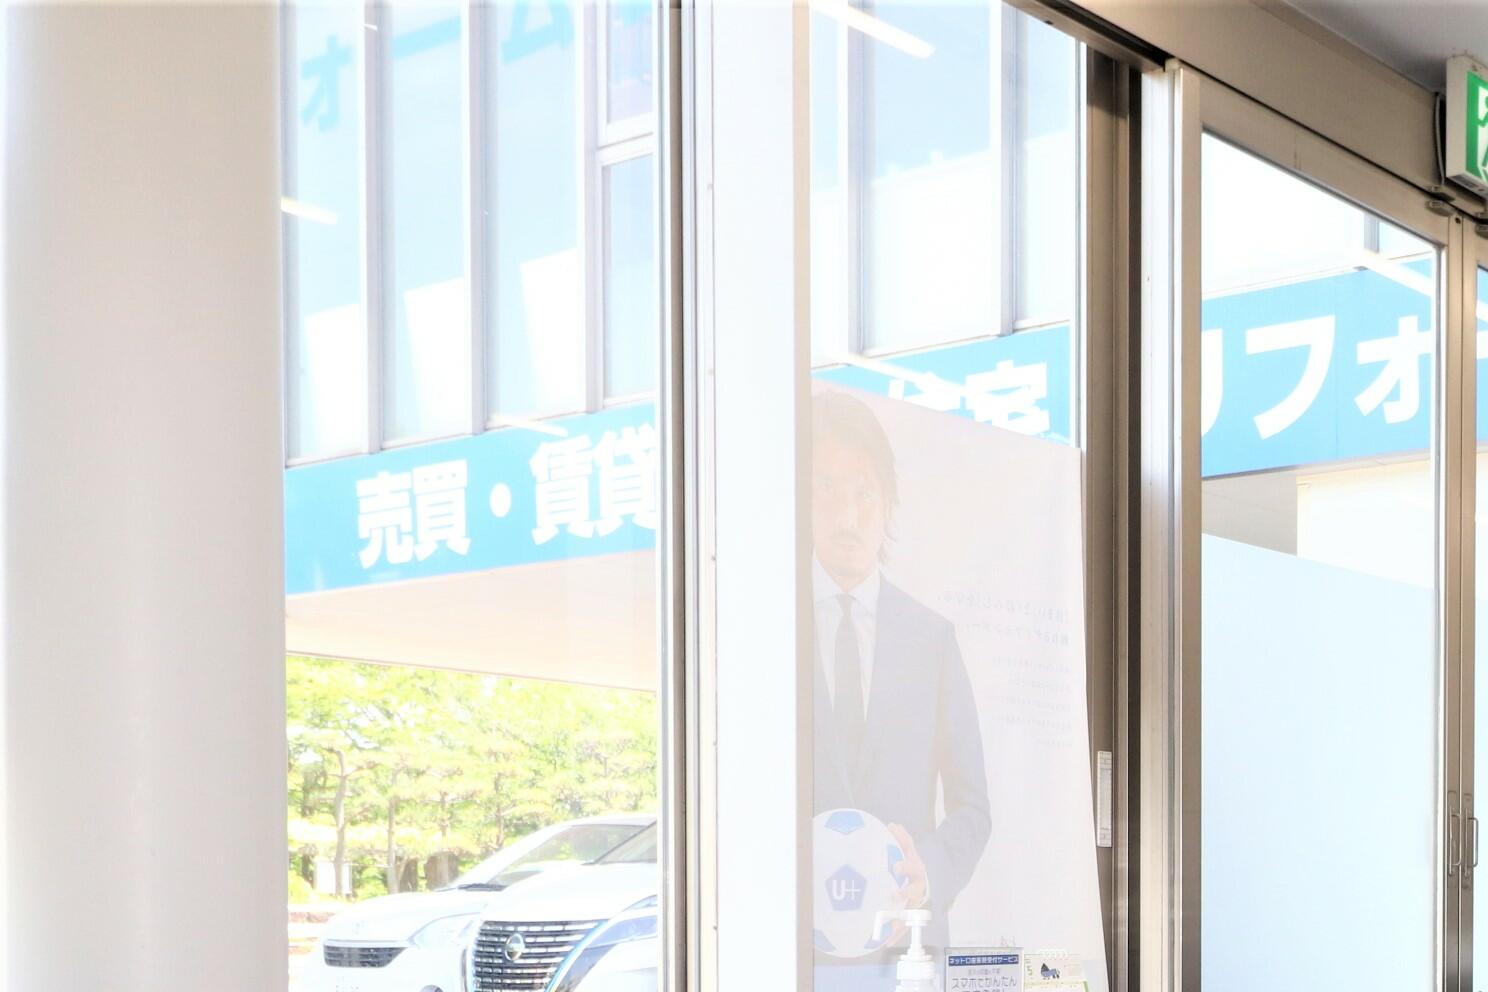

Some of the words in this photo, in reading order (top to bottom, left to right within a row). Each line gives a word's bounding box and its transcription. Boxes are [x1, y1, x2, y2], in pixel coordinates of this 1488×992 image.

[356, 421, 657, 569] 売買・賃貸
